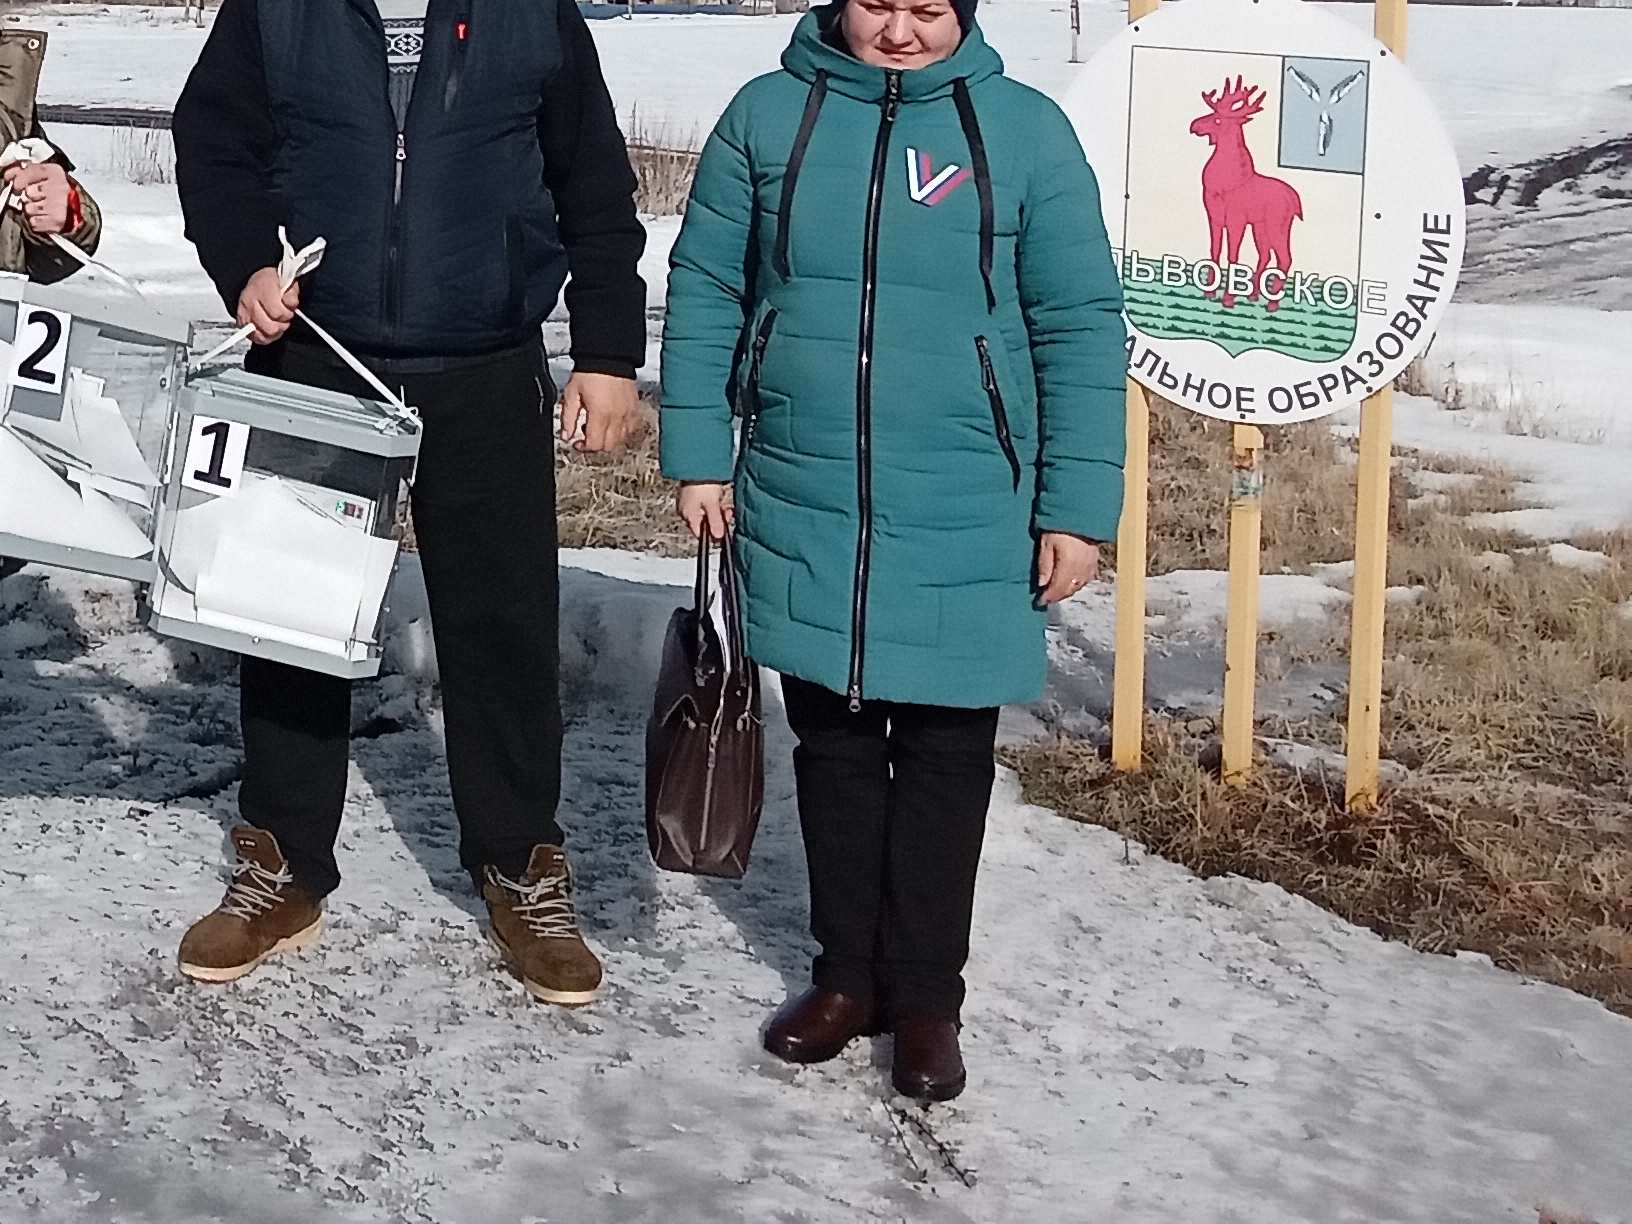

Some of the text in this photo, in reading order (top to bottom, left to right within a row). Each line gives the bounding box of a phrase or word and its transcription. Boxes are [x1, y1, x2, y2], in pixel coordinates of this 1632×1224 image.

[17, 310, 62, 384] 2
[1268, 212, 1452, 414] ОБРАЗОВАНИЕ
[193, 421, 233, 488] 1
